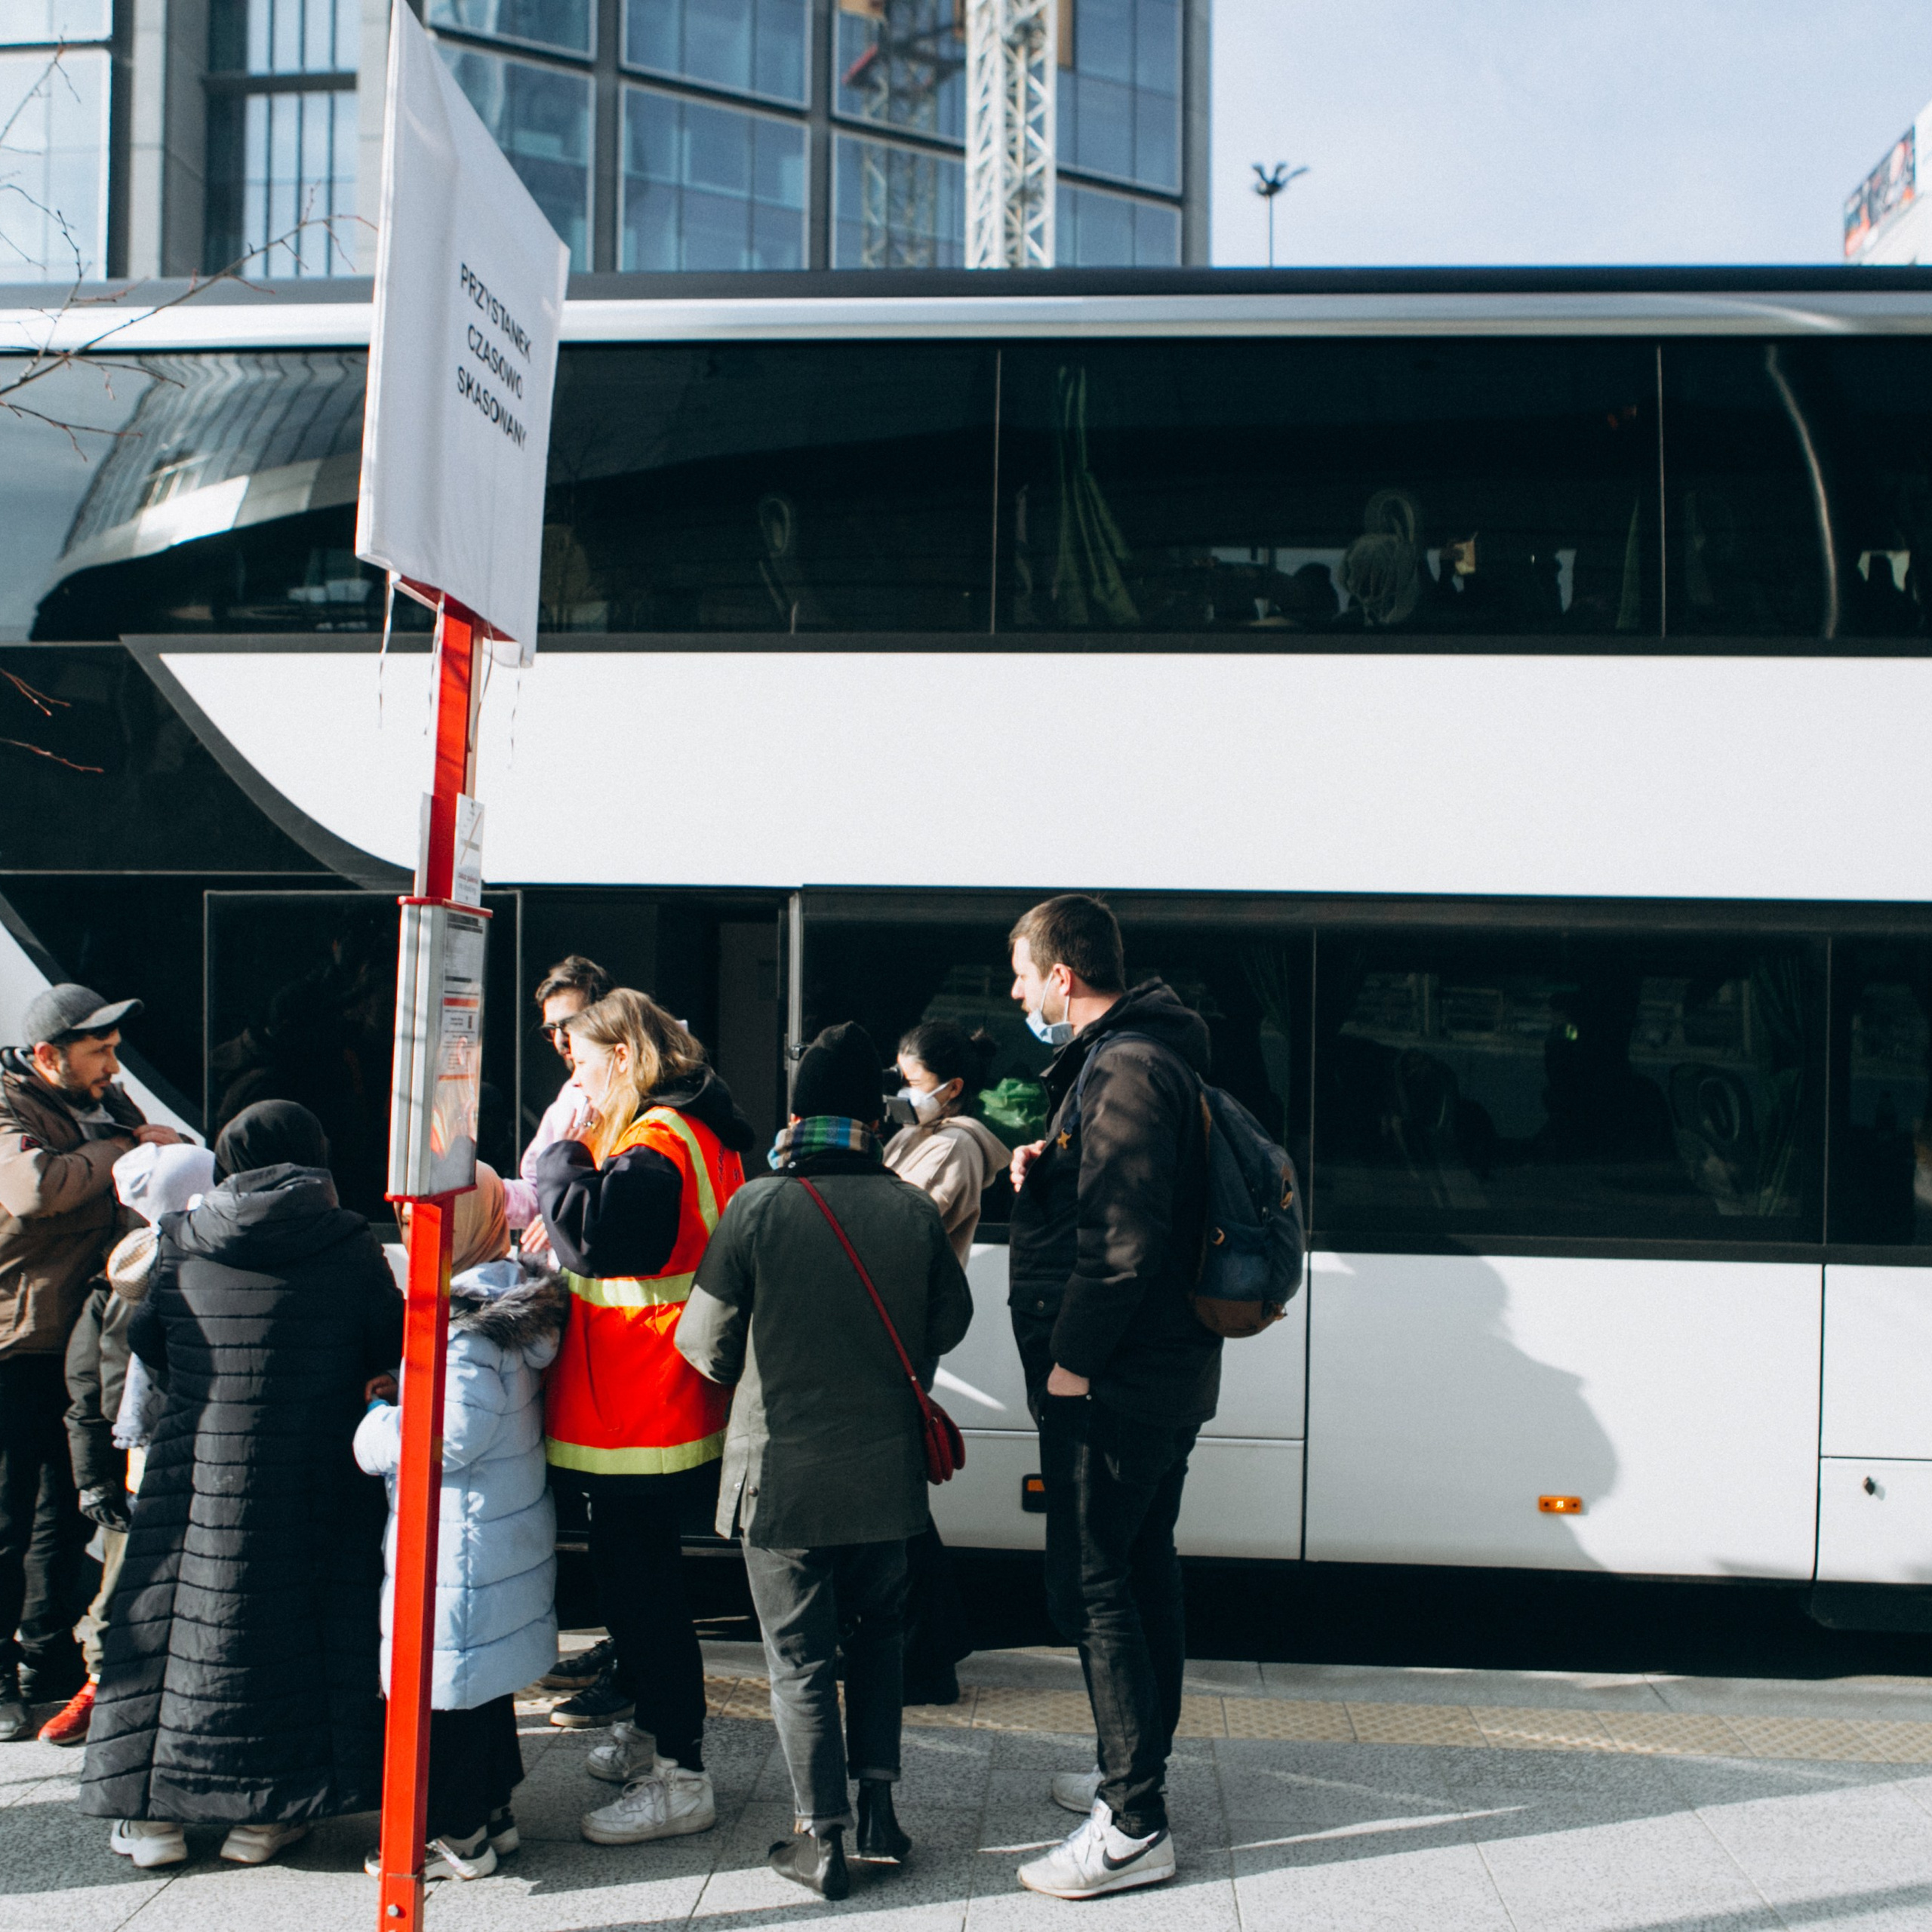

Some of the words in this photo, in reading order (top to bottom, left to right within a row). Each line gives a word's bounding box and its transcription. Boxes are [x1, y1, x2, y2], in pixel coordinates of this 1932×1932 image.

[461, 262, 531, 364] PRZYSTANEK
[468, 323, 523, 399] CZASOWO
[457, 365, 527, 451] SKASOWANY
